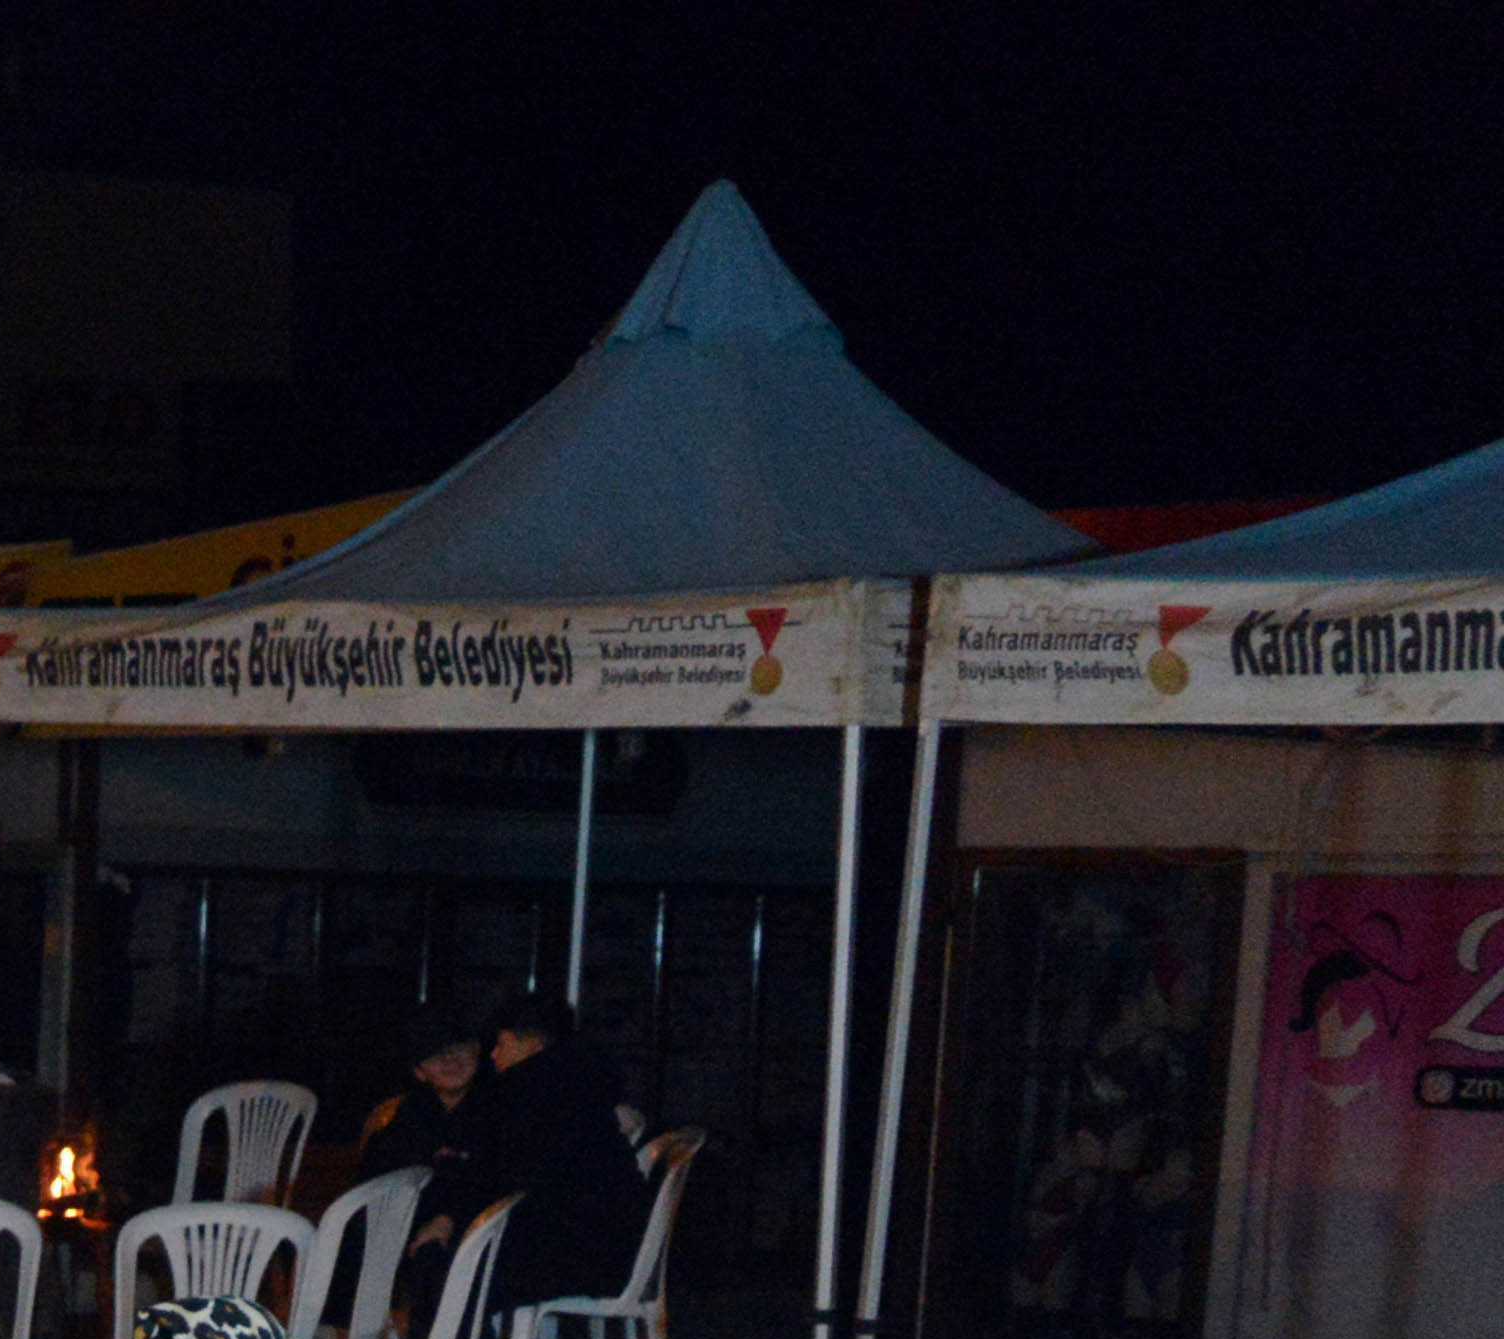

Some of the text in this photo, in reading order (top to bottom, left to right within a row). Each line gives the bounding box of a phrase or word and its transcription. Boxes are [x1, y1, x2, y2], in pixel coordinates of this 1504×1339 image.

[600, 641, 747, 664] Kahramanmaraş
[958, 626, 1139, 657] Kahramanmaraş
[1232, 610, 1504, 677] Kahramanm
[27, 618, 575, 703] Kahramanmaraş Büyükşehir Belediyesi
[958, 659, 1144, 685] Büyükşehir Belediyesi
[600, 666, 747, 689] Büyükşehir Belediyesi
